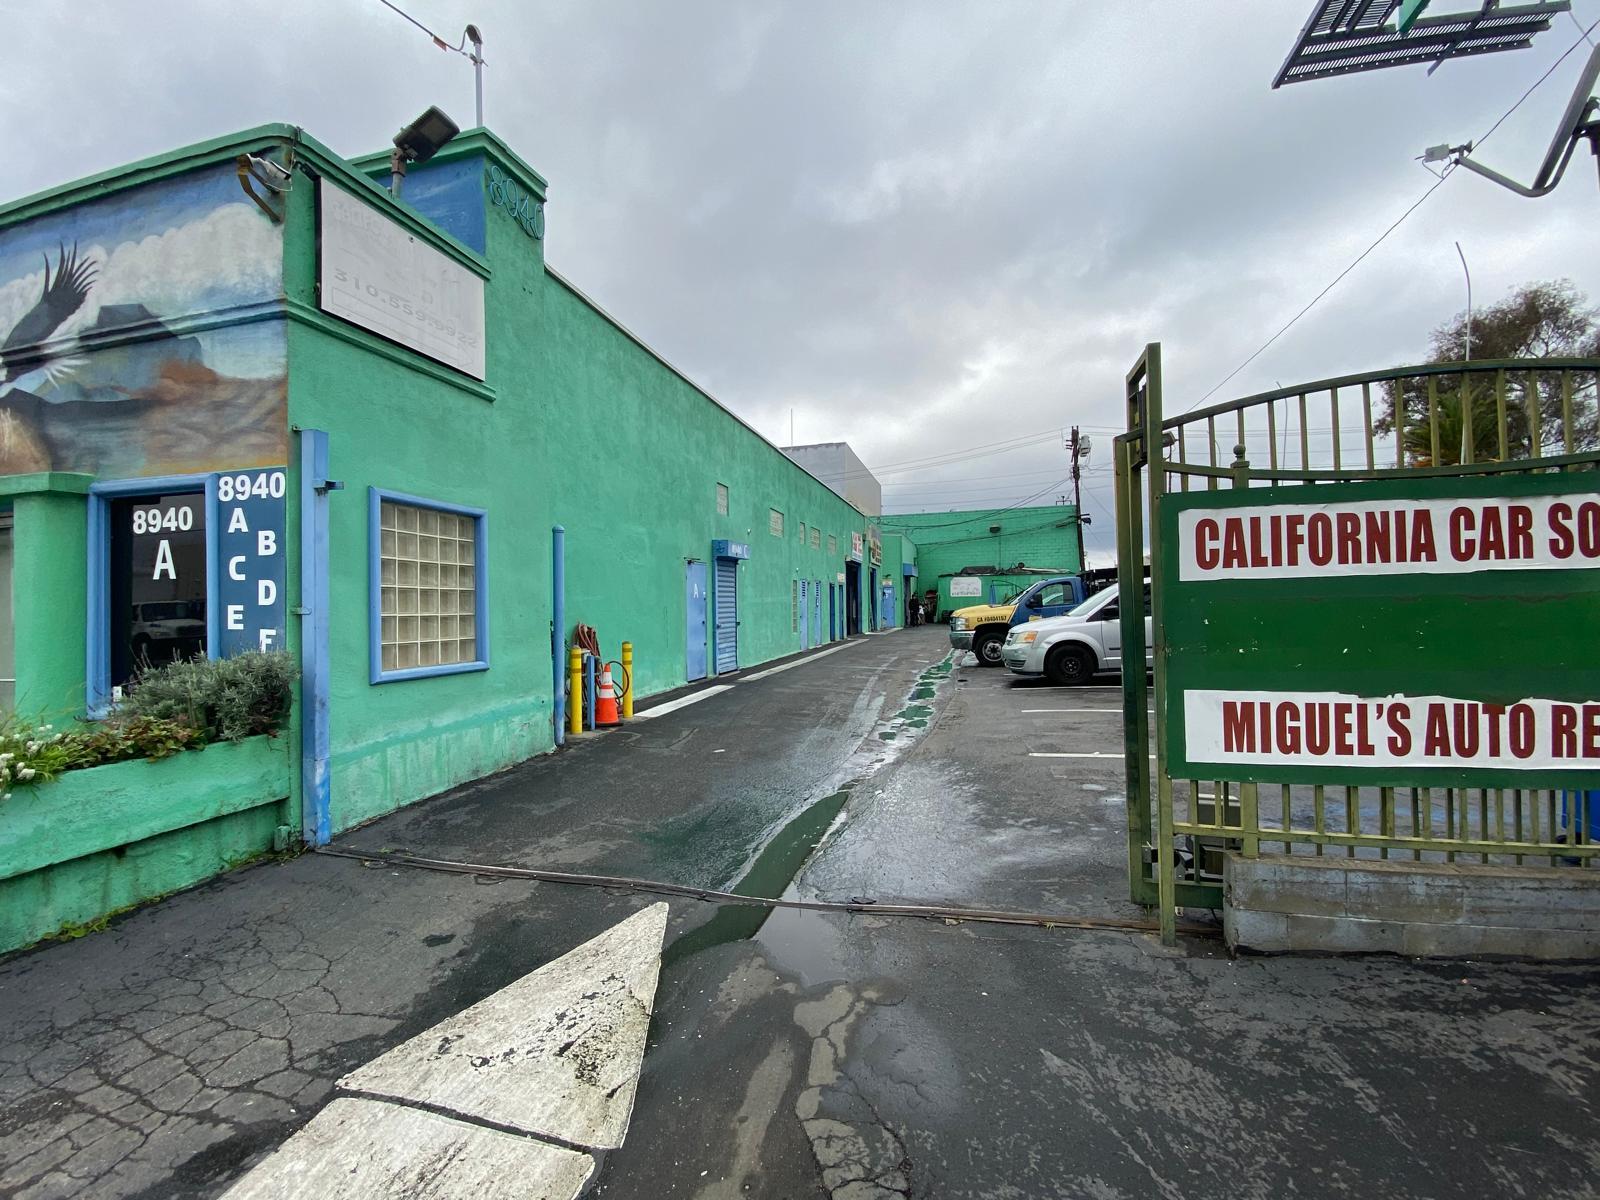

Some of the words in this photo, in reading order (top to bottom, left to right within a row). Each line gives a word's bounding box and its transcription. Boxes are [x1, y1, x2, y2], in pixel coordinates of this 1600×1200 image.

[490, 165, 546, 240] 8940
[218, 472, 286, 502] 8940
[132, 506, 193, 535] 8940
[228, 507, 249, 533] A
[258, 530, 277, 556] B
[1195, 508, 1438, 571] CALIFORNIA
[1449, 505, 1535, 563] CAR
[1548, 501, 1600, 560] SO
[152, 539, 177, 580] A
[228, 555, 246, 581] C
[258, 579, 277, 606] D
[227, 604, 244, 630] E
[259, 628, 277, 654] F
[1222, 701, 1412, 758] MIGUEL'S
[1424, 703, 1536, 759] AUTO
[1551, 704, 1600, 759] RE
